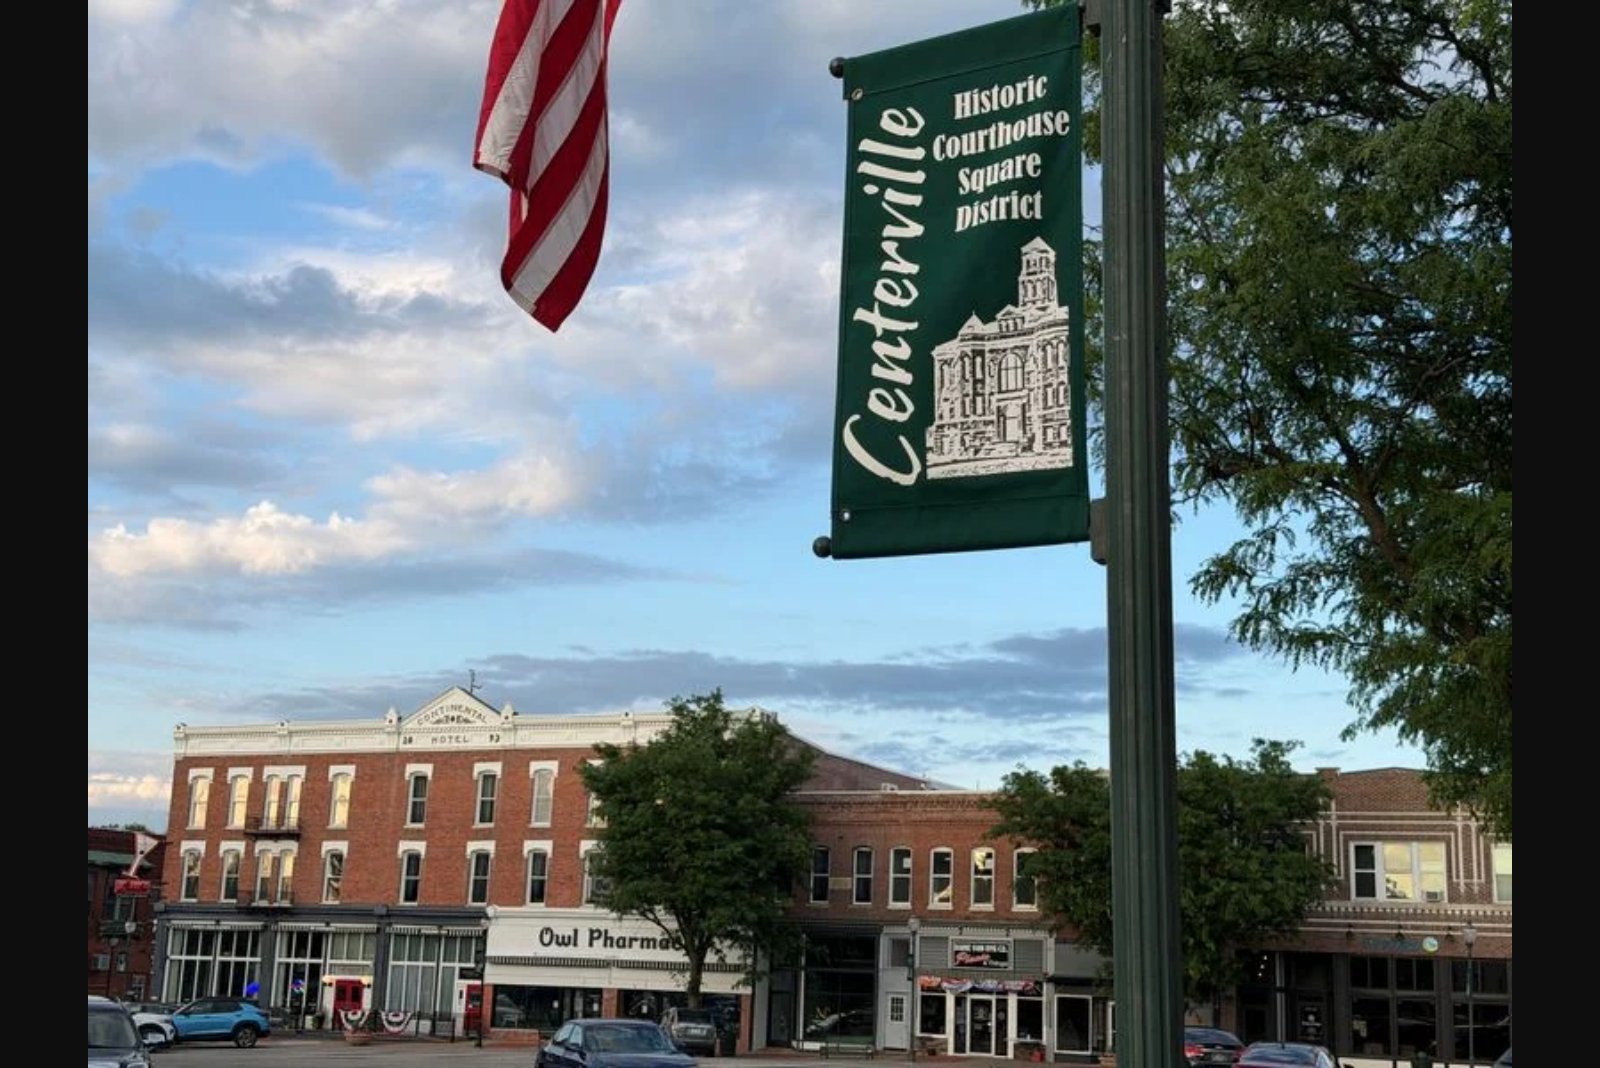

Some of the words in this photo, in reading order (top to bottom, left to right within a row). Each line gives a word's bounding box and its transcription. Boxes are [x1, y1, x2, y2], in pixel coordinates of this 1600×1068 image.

[953, 74, 1048, 120] Historic
[932, 109, 1070, 161] Courthouse
[958, 152, 1042, 195] Square
[954, 190, 1043, 233] District
[843, 106, 926, 486] Centerville
[416, 704, 488, 726] CONTINENTAL
[431, 734, 468, 744] HOTEL
[539, 927, 578, 947] Owl
[588, 927, 685, 951] Pharmac
